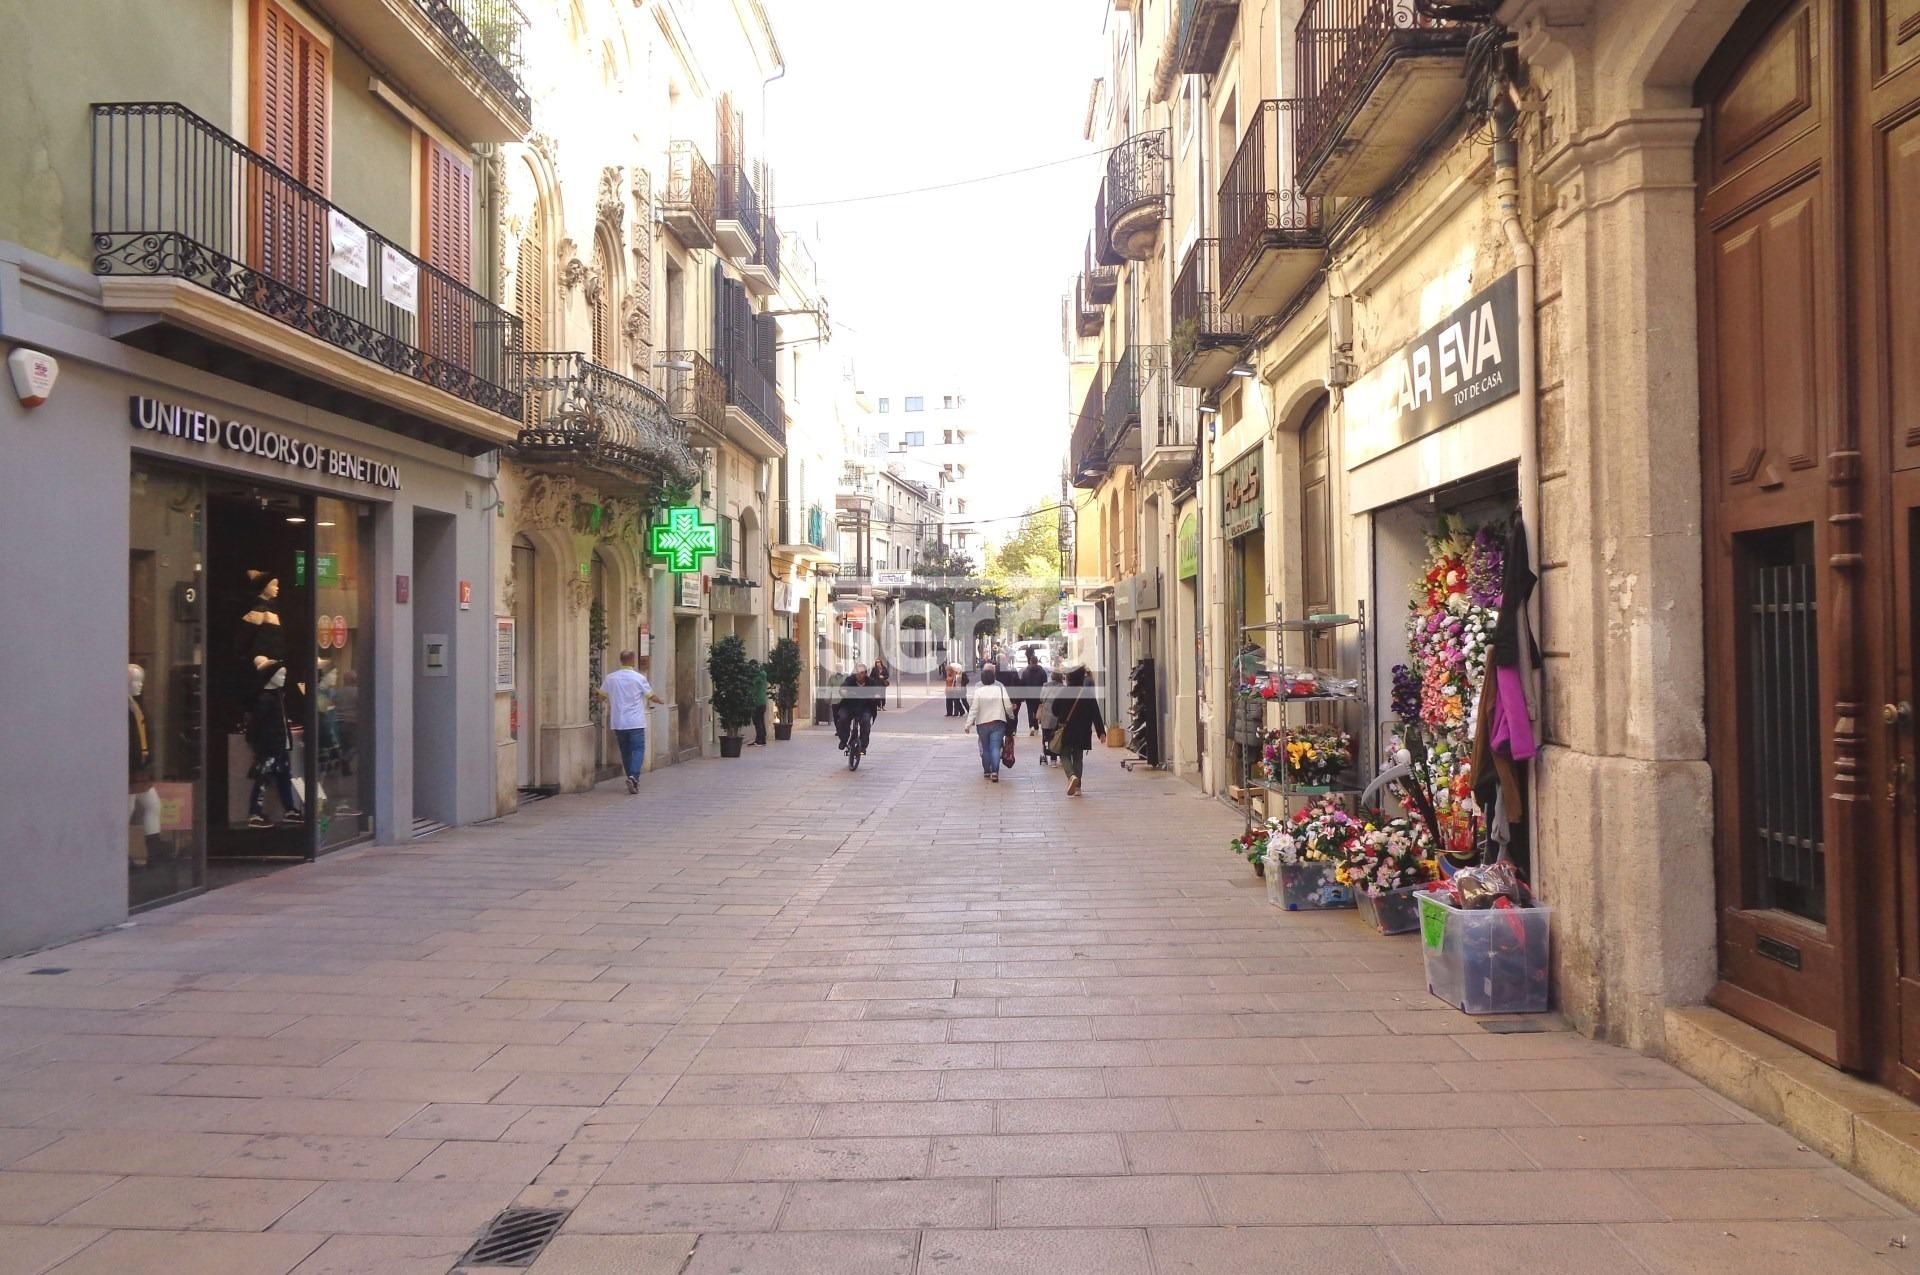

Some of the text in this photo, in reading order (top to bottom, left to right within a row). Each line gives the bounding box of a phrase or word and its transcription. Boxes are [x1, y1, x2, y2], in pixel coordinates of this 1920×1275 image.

[1438, 300, 1502, 395] EVA
[1453, 370, 1503, 406] TOT DE CASA
[138, 396, 221, 444] UNITED
[225, 420, 299, 465] COLORS
[302, 442, 326, 471] OF
